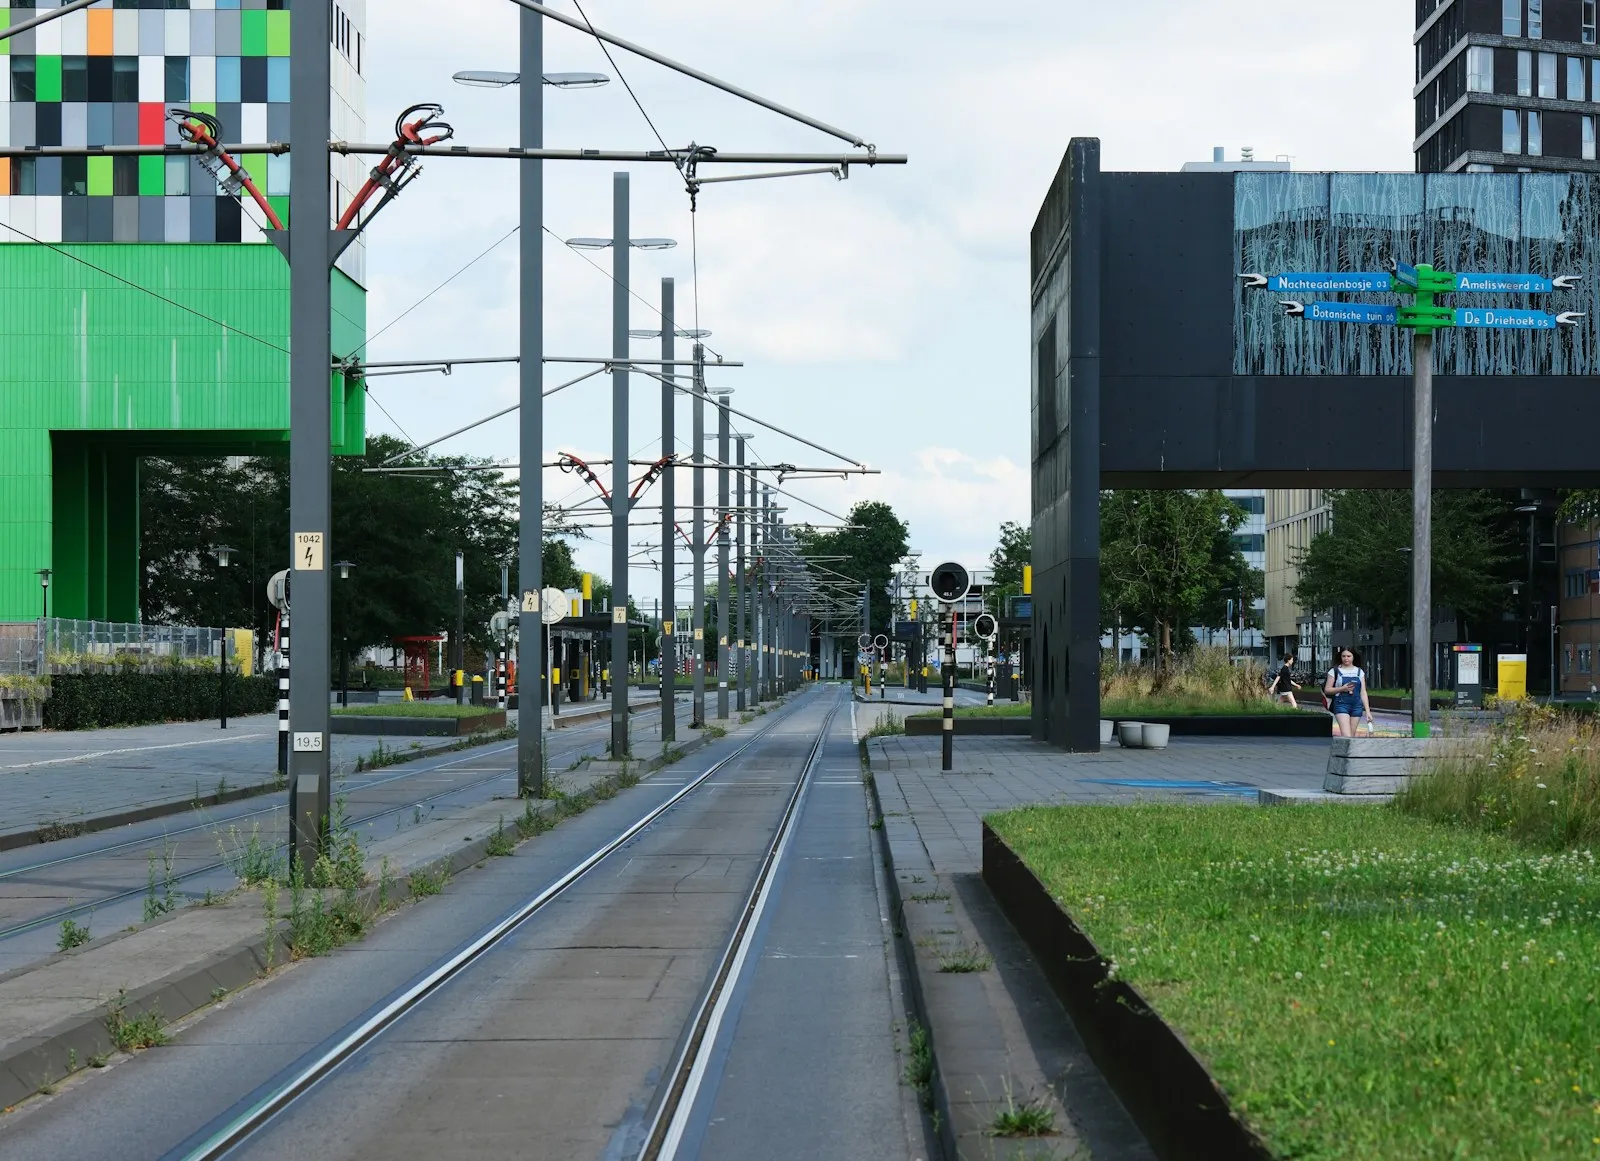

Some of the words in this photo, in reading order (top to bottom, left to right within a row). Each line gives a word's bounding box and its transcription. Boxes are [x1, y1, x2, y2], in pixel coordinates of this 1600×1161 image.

[1279, 277, 1372, 290] Nachtegalenbosje
[1460, 277, 1529, 290] Amelisweerd
[1313, 305, 1361, 320] Botanische
[1367, 313, 1382, 321] tuin
[1465, 312, 1480, 324] De
[1486, 312, 1534, 326] Driehoek
[298, 535, 320, 543] 1042
[296, 737, 321, 748] 19,5
